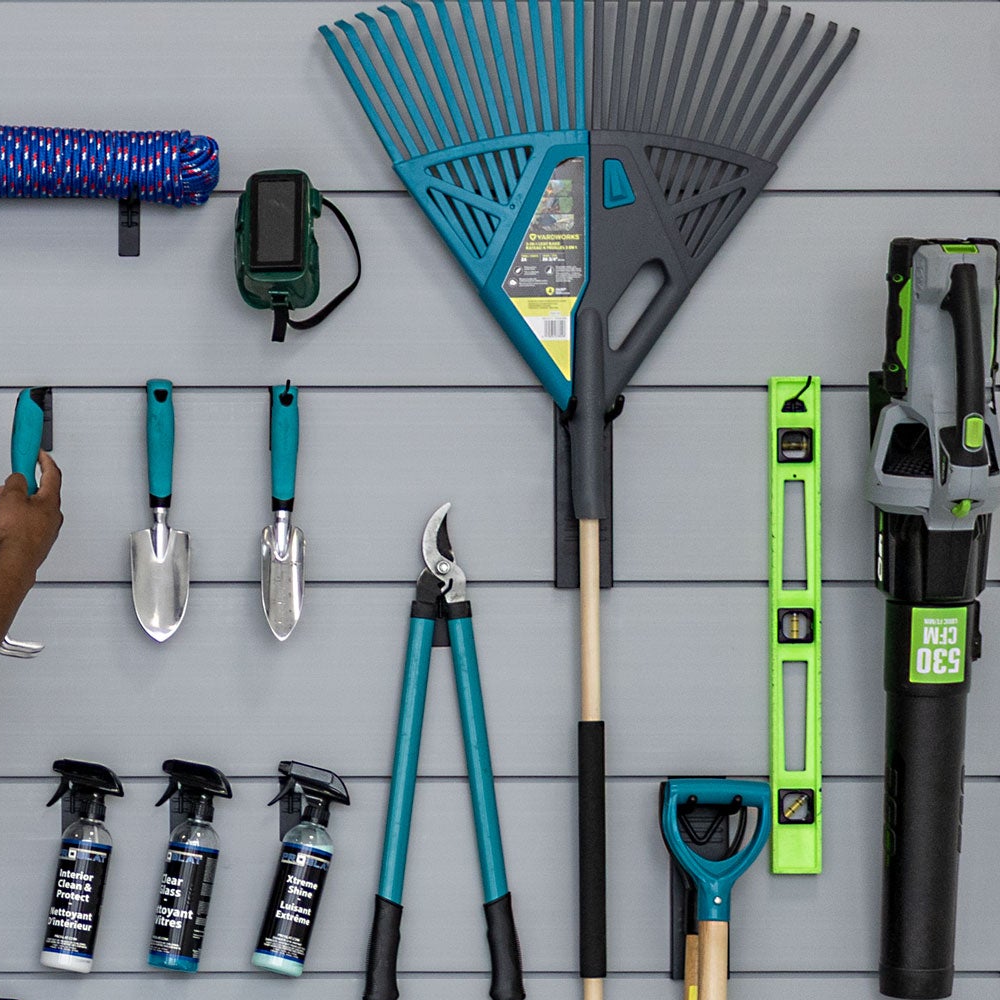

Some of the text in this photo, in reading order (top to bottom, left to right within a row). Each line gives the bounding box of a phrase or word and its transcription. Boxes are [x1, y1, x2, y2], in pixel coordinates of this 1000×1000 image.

[923, 626, 957, 645] CFM
[916, 647, 961, 675] 530
[281, 852, 330, 870] PROSLA
[59, 868, 94, 882] Interior
[286, 874, 318, 890] Xtreme
[58, 879, 92, 892] Clean &
[287, 885, 313, 899] Shine
[56, 889, 90, 903] Protect
[50, 906, 93, 921] Nettoyant
[280, 900, 312, 917] Luisant
